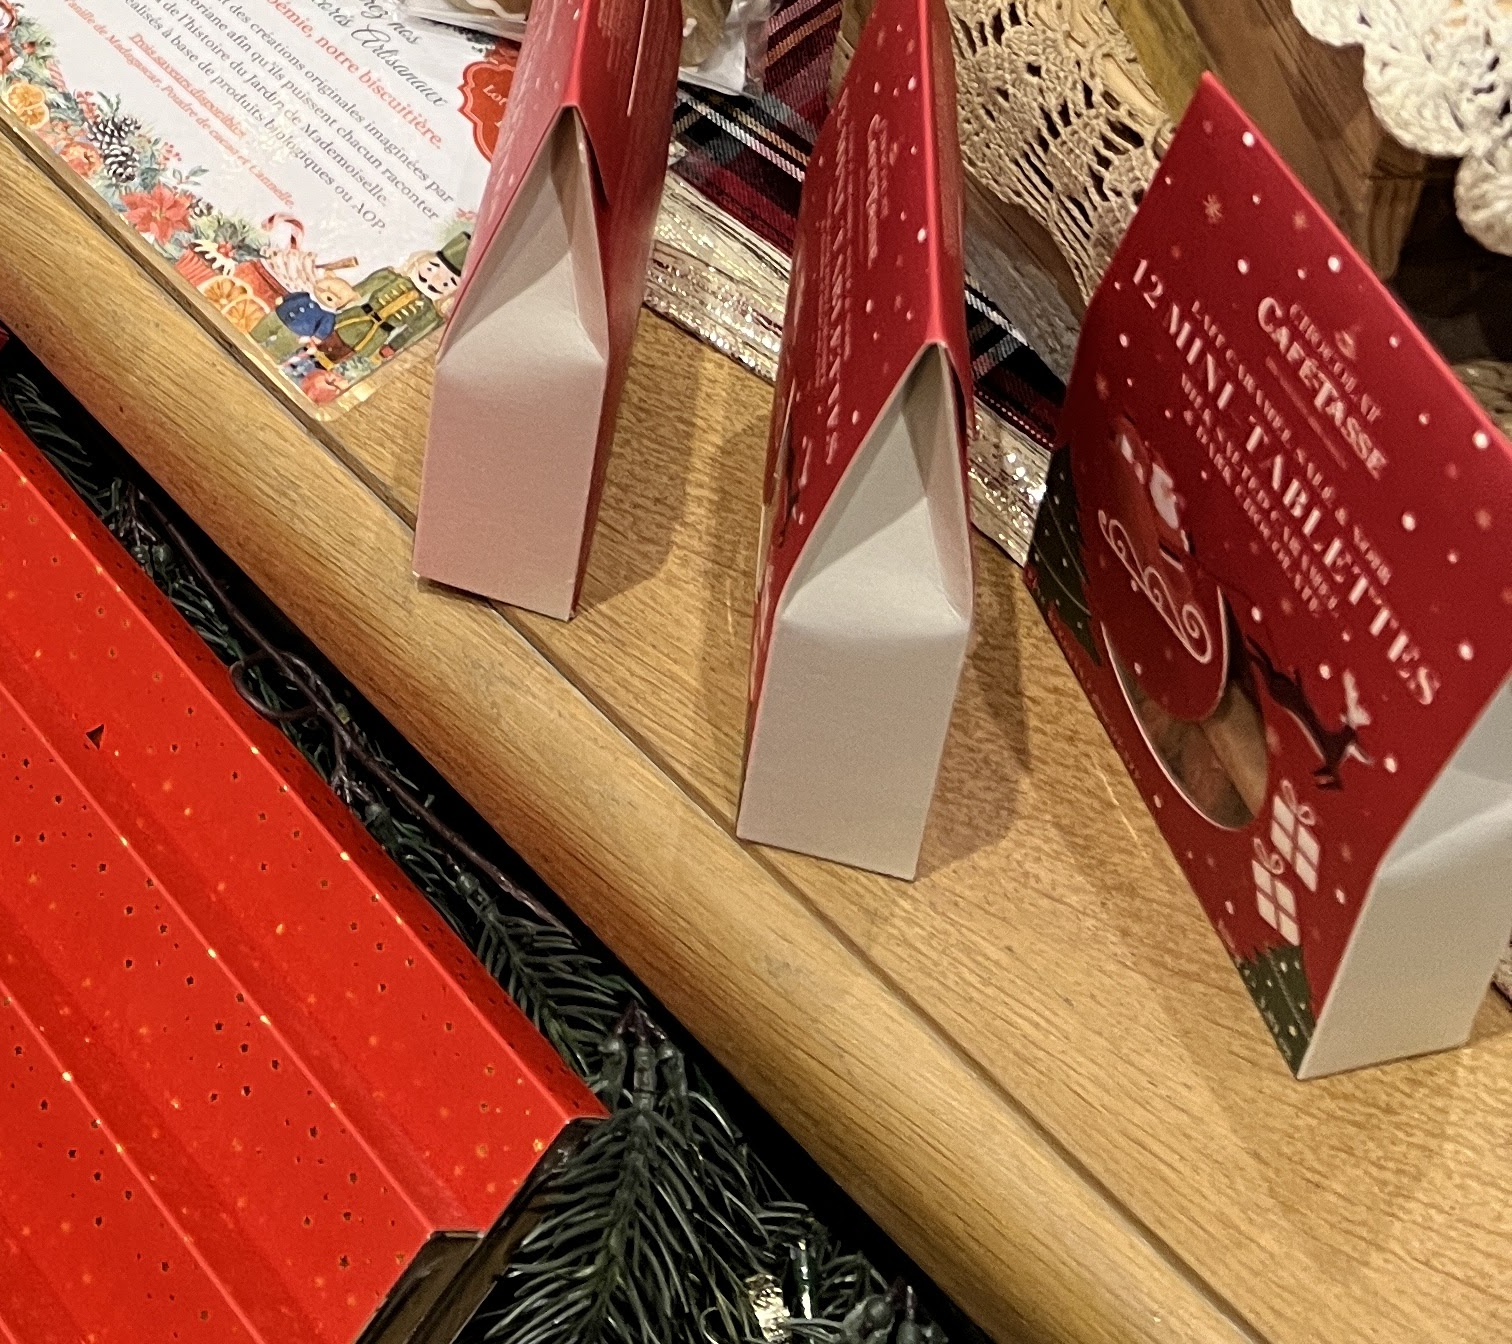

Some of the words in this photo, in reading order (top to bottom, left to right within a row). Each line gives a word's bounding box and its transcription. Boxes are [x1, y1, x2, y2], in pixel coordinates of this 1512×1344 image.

[170, 34, 199, 61] base
[210, 74, 264, 122] produits
[177, 13, 230, 60] l'histoire
[350, 16, 449, 105] Artisanaux
[387, 20, 419, 45] nos
[226, 29, 252, 52] afin
[280, 80, 338, 128] puissent
[336, 126, 383, 169] chacun
[381, 168, 438, 219] raconter
[229, 4, 250, 23] des
[250, 22, 306, 71] créations
[304, 69, 365, 123] originales
[364, 122, 429, 181] imaginées
[425, 180, 454, 203] par
[315, 35, 359, 72] notre
[358, 70, 444, 149] biscuitière.
[1132, 260, 1165, 308] 12
[1165, 304, 1235, 409] MINI
[1241, 417, 1443, 709] TABLETTES
